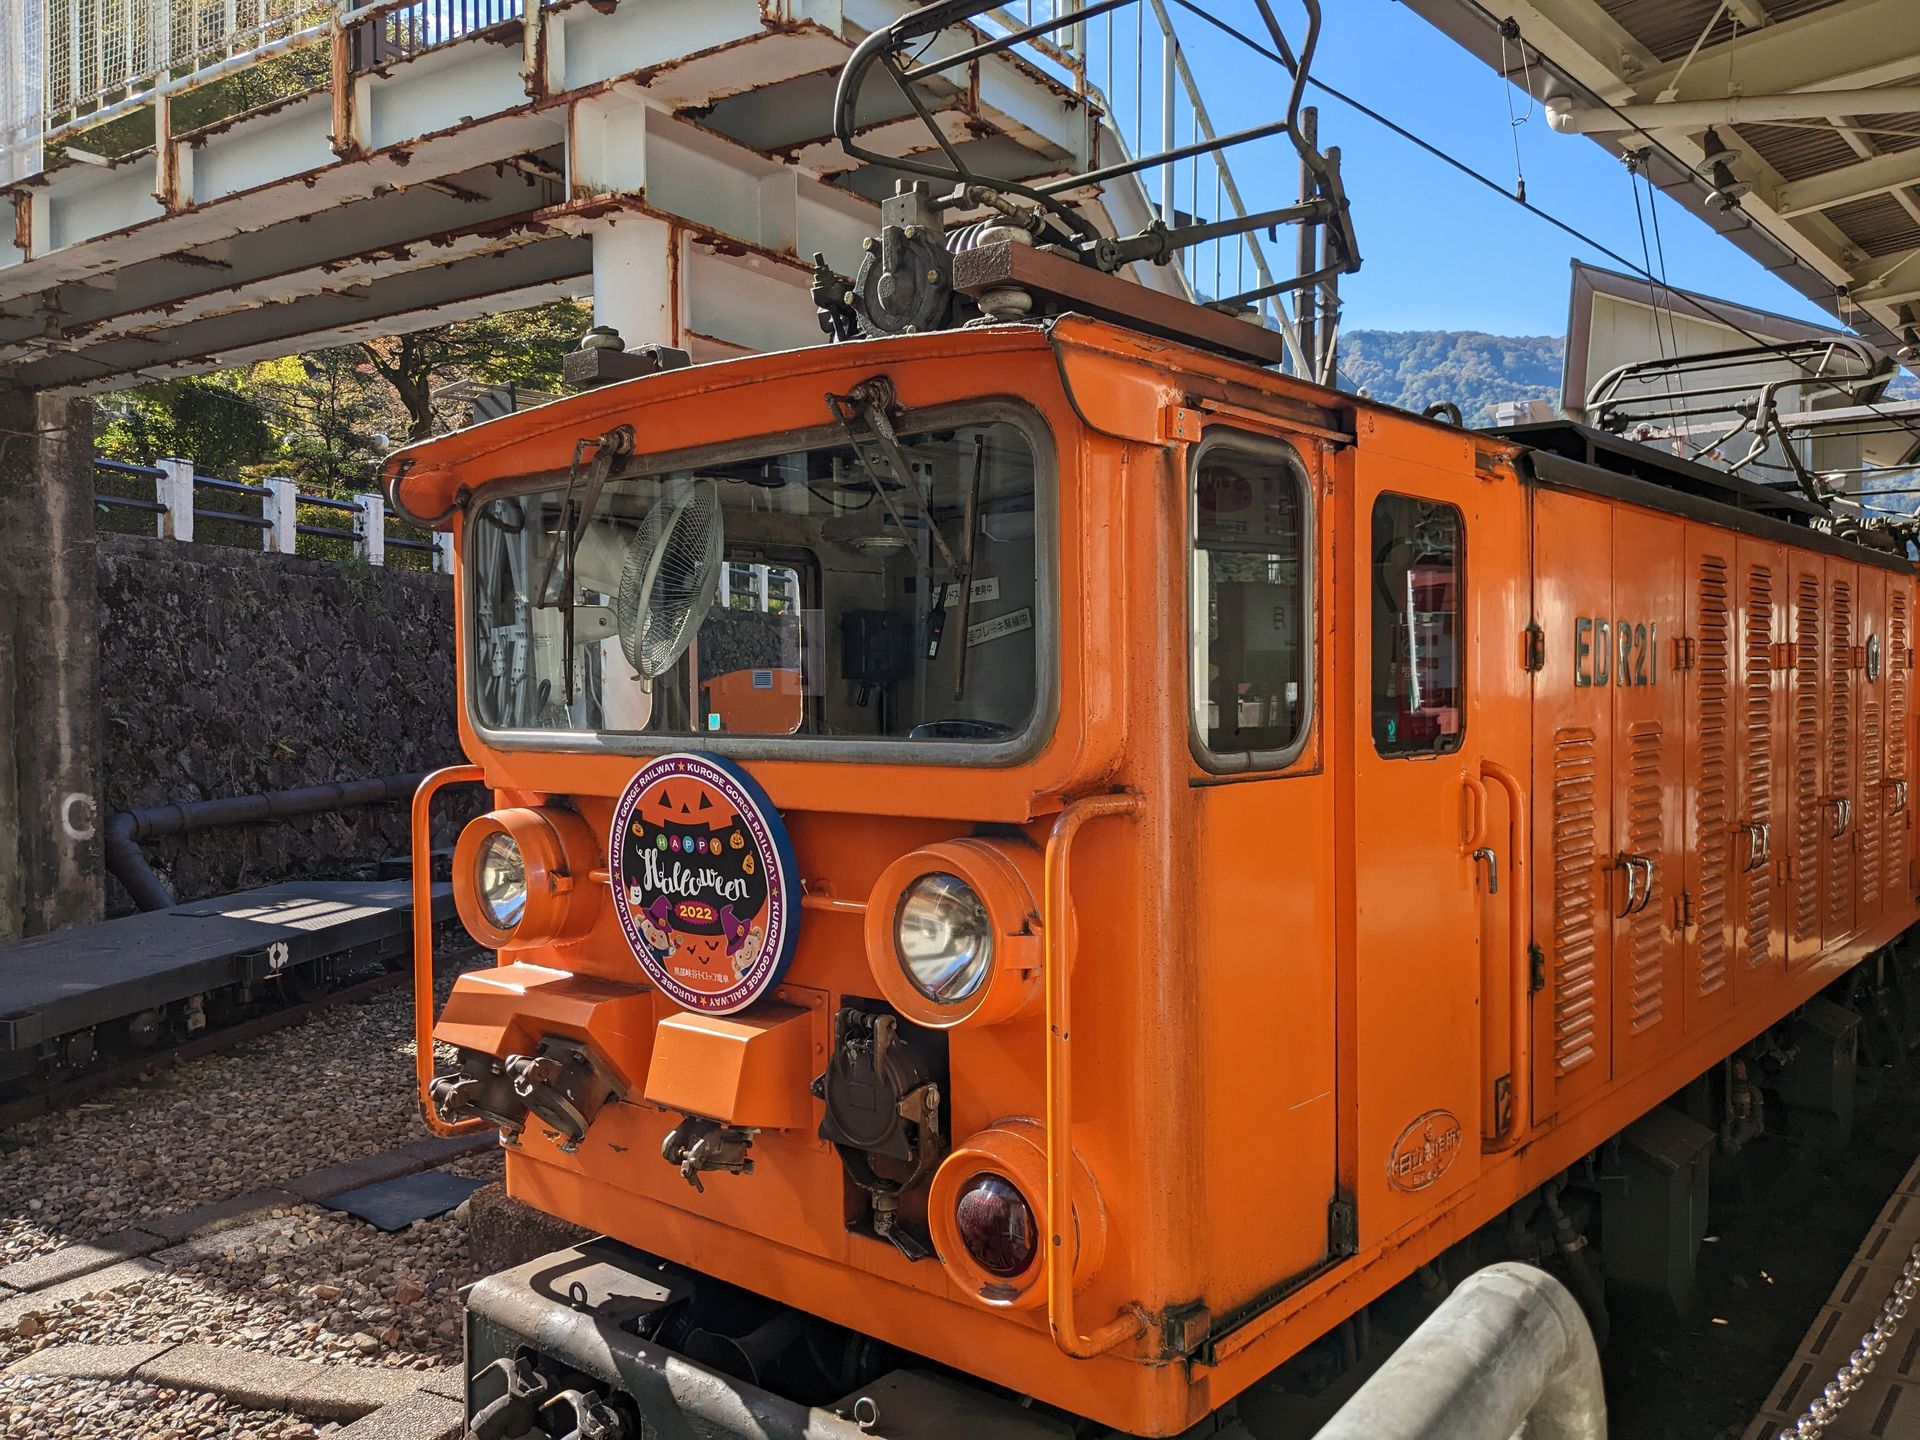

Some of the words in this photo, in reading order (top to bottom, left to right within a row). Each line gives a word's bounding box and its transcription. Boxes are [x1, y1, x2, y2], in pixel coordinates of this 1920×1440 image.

[1575, 616, 1657, 687] EDR21
[613, 818, 624, 867] KUROBE
[621, 784, 641, 817] GORGE
[639, 763, 675, 787] RAILWAY
[687, 763, 725, 787] KUROBE
[726, 785, 755, 821] GORGE
[753, 821, 777, 882] RAILWAY
[658, 838, 719, 851] HAPPY
[635, 844, 751, 901] Halloween
[615, 885, 637, 940] RAILWAY
[680, 905, 713, 920] 2022
[765, 901, 780, 955] KUROBE
[634, 944, 661, 978] GORGE
[747, 955, 770, 990] GORGE
[660, 977, 697, 1003] KUROBE
[709, 986, 748, 1007] RAILWAY
